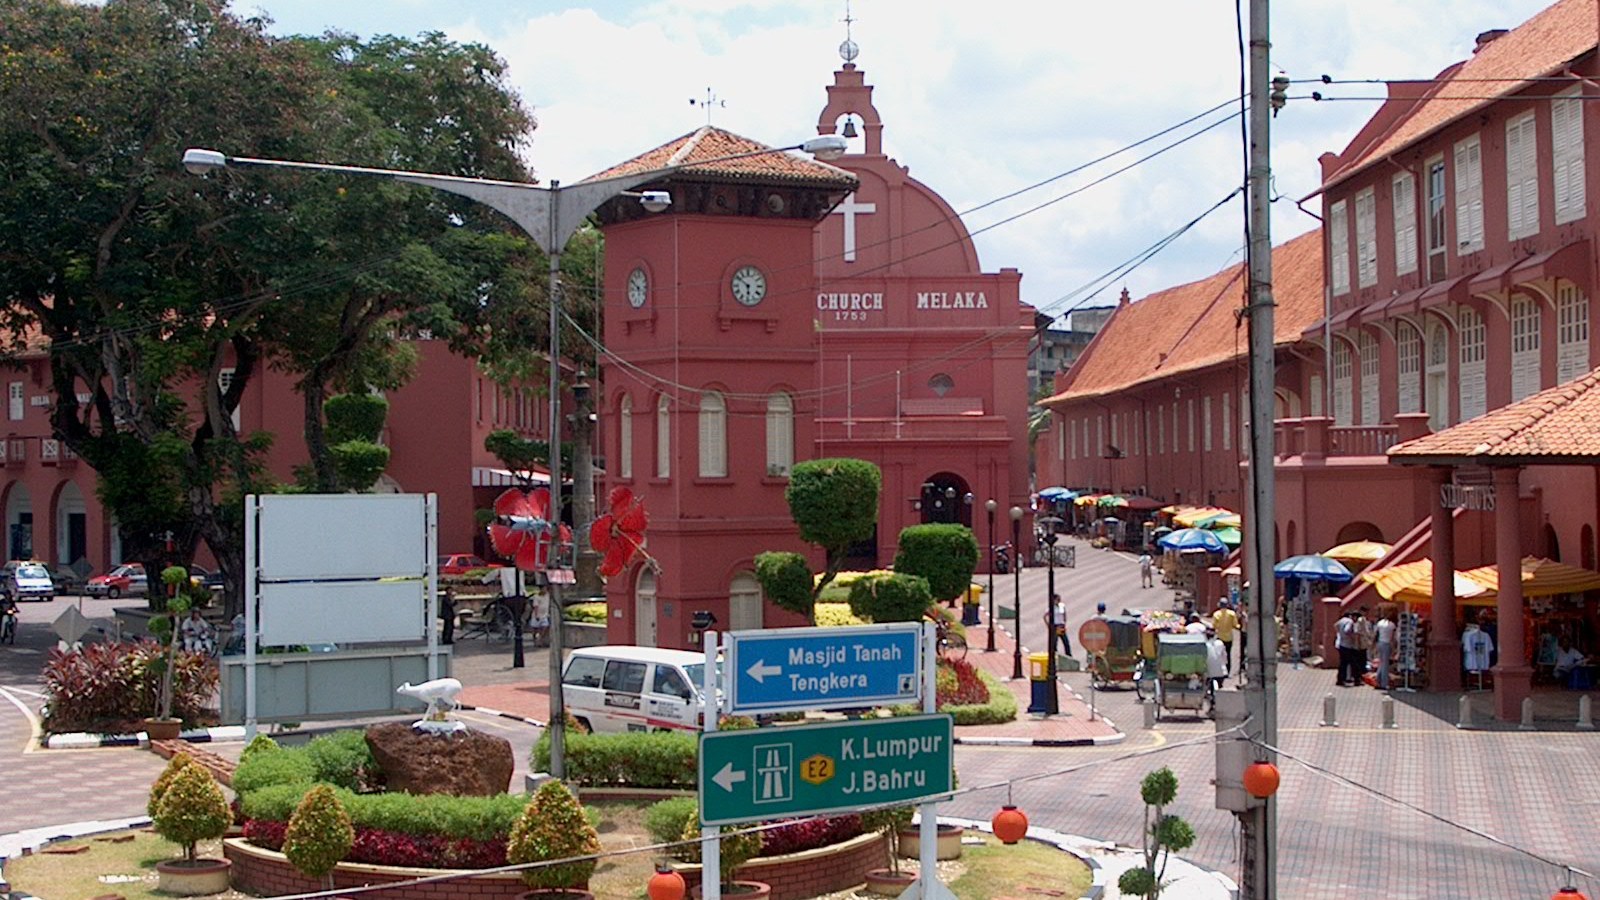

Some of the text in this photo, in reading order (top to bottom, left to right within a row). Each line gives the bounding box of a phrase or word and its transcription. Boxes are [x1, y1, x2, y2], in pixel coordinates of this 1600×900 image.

[817, 292, 988, 310] CHURCH MELAKA
[835, 311, 867, 321] 1753
[788, 644, 902, 668] Masjid Tanah
[788, 673, 868, 694] Tengkera
[841, 735, 943, 761] K.Lumpur
[808, 759, 829, 778] E2
[841, 768, 926, 795] J.Bahru
